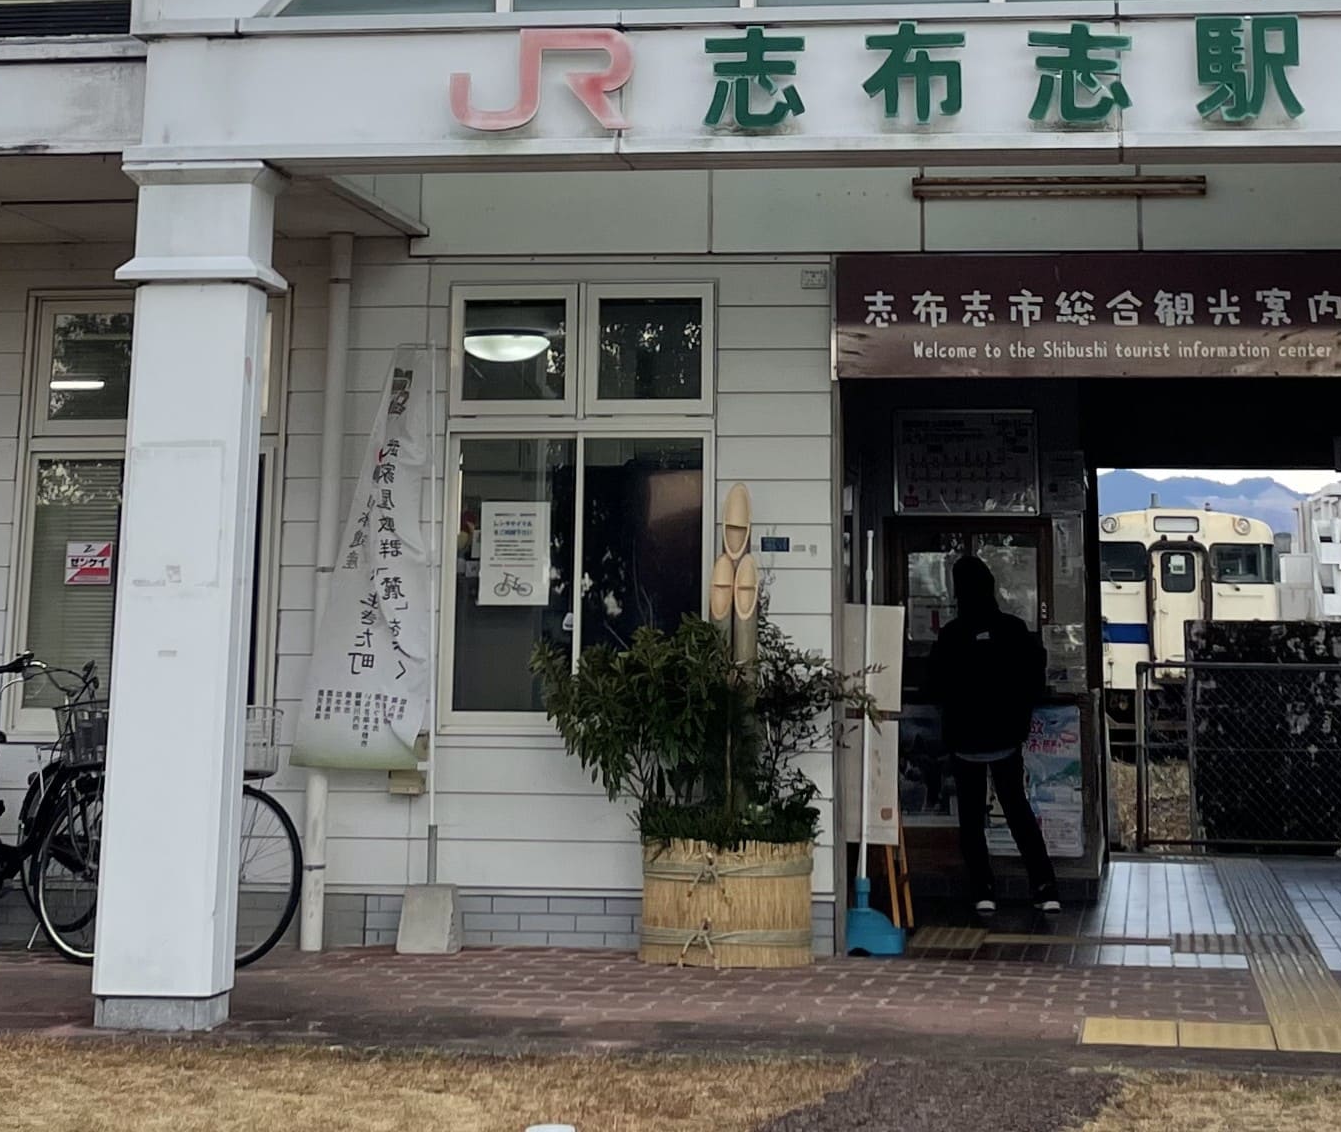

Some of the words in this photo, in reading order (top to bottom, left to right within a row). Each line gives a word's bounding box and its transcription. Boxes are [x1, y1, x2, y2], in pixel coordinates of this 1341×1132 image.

[449, 27, 633, 132] JR
[702, 13, 1306, 128] 志布志駅
[913, 341, 977, 360] Welcome
[984, 343, 1002, 359] to
[1008, 341, 1035, 359] the
[1042, 340, 1108, 360] Shibushi
[1115, 341, 1171, 359] tourist
[1177, 340, 1270, 359] information
[1278, 341, 1333, 359] center
[70, 557, 108, 568] ゼンケイ
